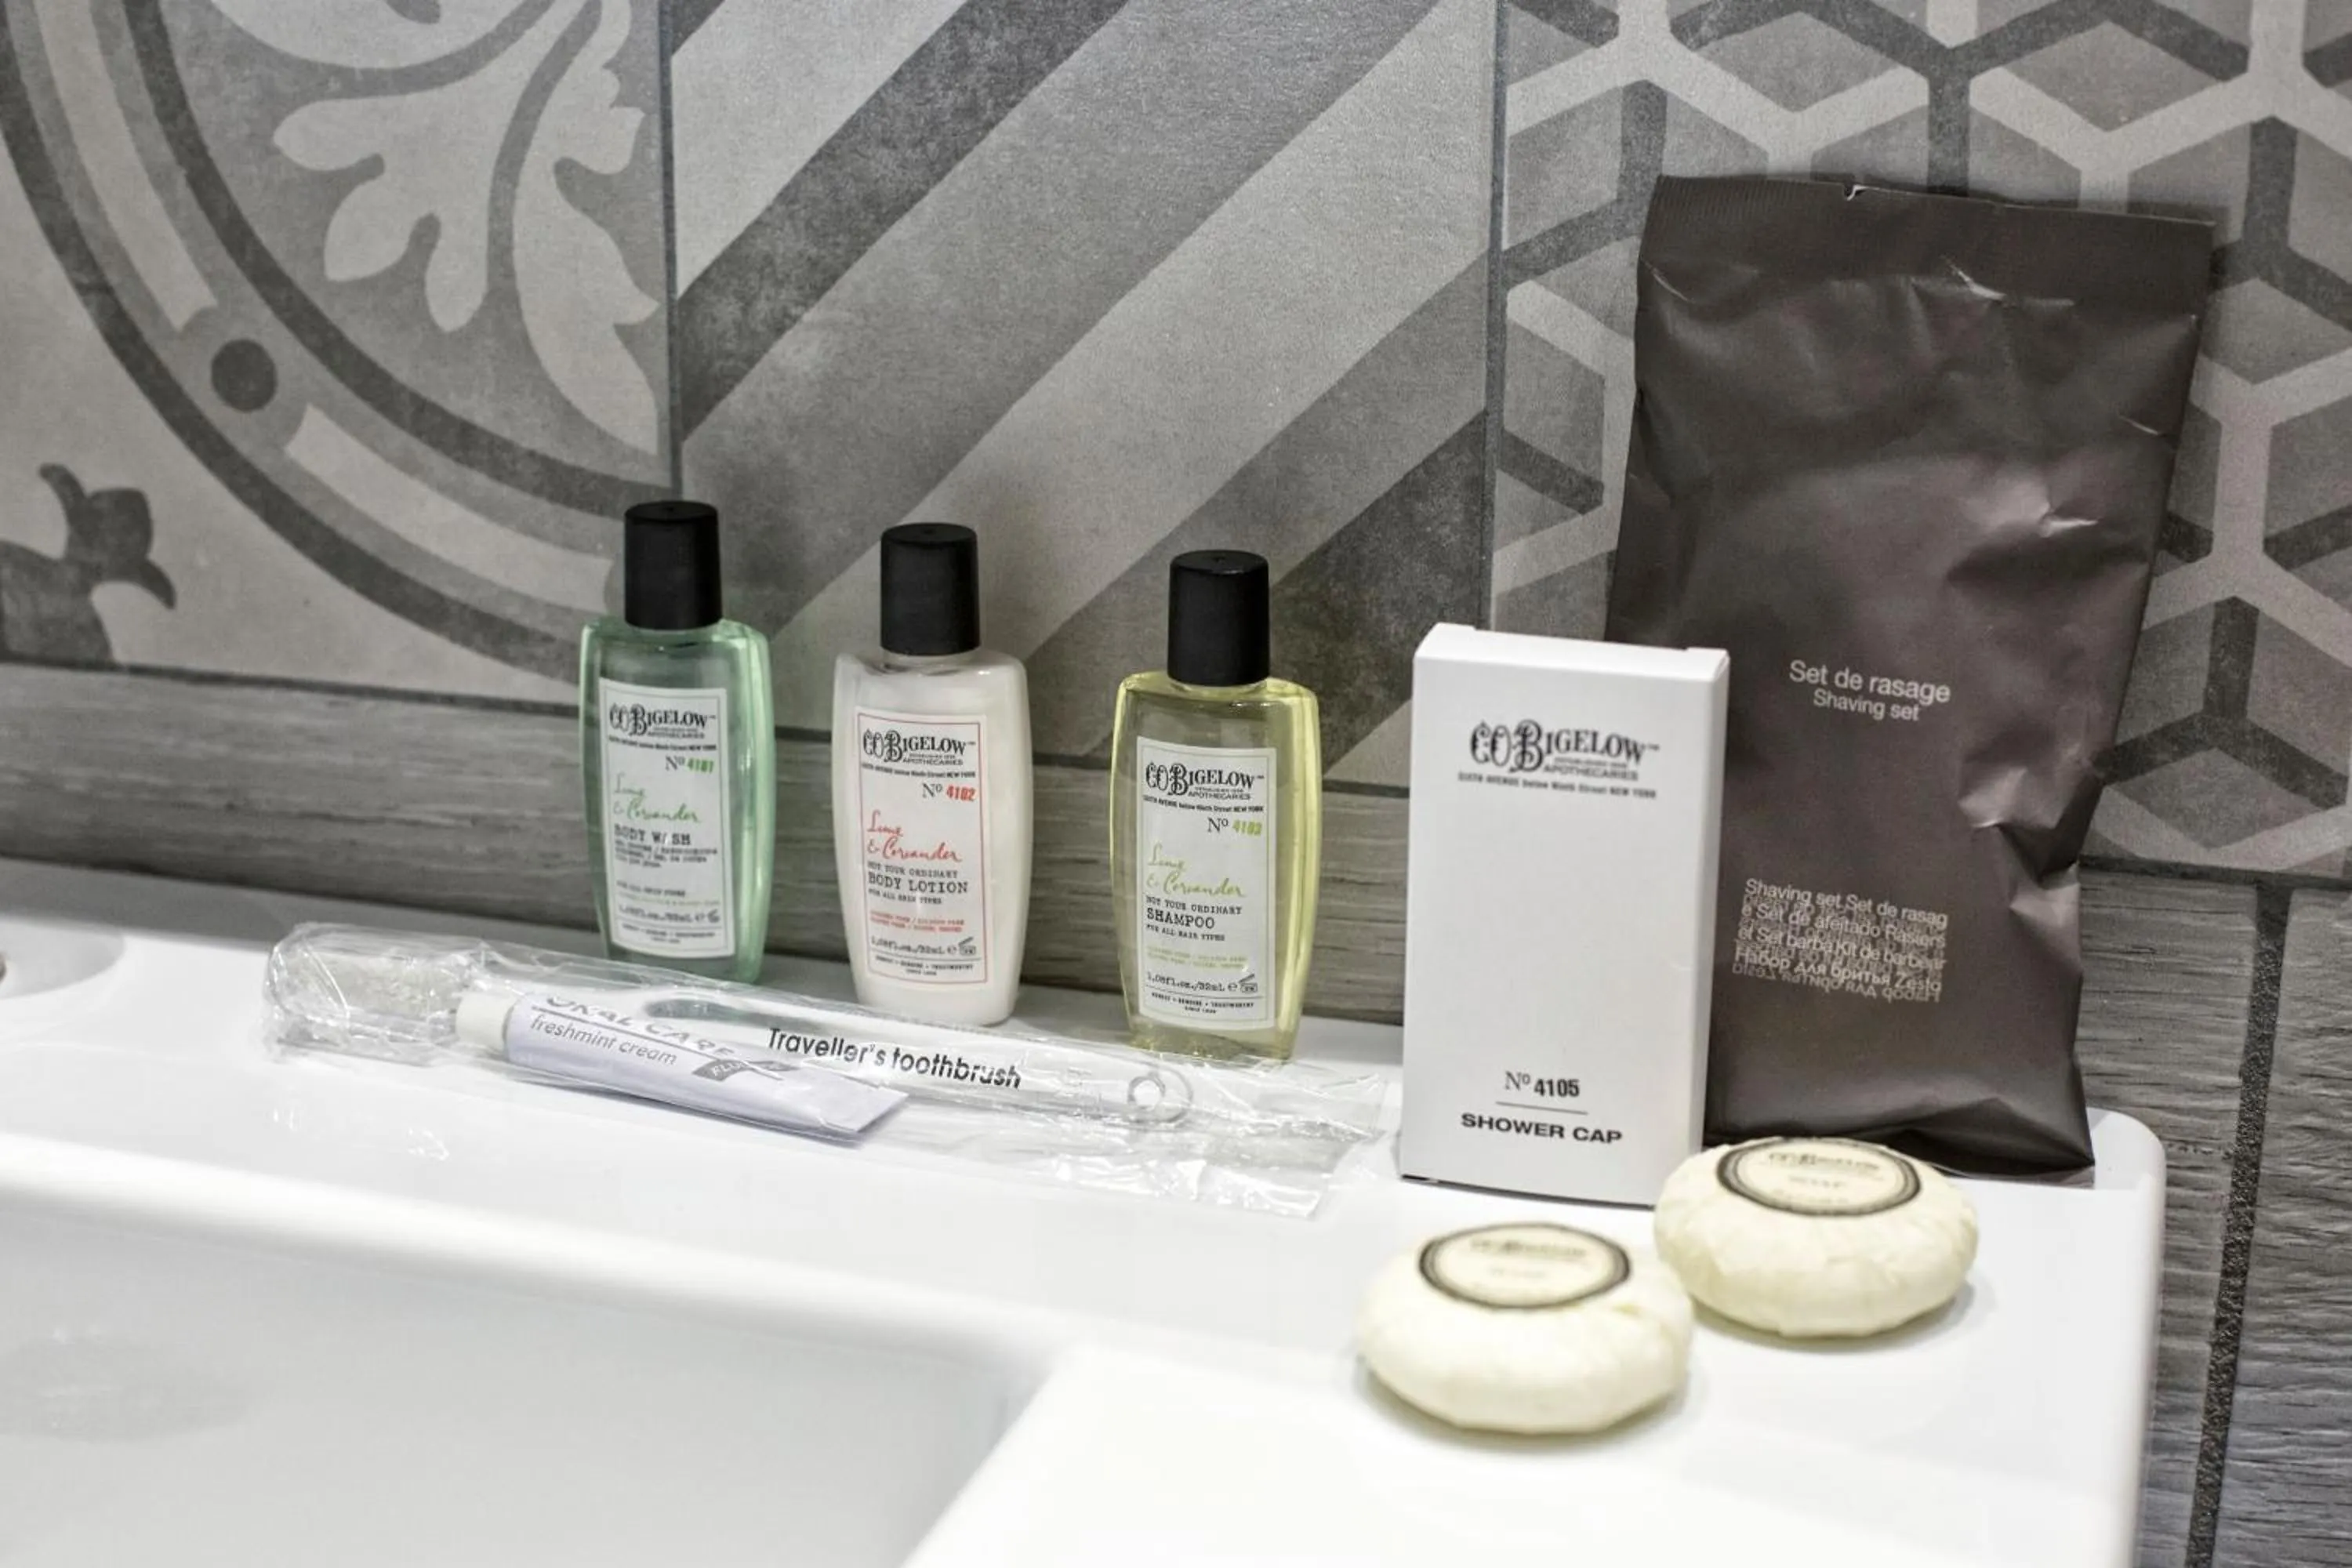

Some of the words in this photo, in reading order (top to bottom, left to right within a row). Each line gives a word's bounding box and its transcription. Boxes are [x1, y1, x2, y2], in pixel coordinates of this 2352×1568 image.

[1789, 659, 1828, 684] Set
[1834, 667, 1863, 691] de
[1869, 675, 1951, 706] rasage
[1813, 688, 1885, 720] Shaving
[1889, 703, 1920, 721] set
[882, 836, 963, 862] Coriander
[868, 872, 902, 890] BODY
[909, 880, 968, 894] LOTION
[1163, 871, 1247, 898] Coriander
[1191, 904, 1243, 915] ORDINARY
[1745, 878, 1812, 905] Shaving
[1816, 891, 1842, 909] set
[1846, 894, 1872, 913] Set
[1876, 900, 1898, 916] de
[1147, 907, 1215, 929] SHAMPOO
[1161, 927, 1175, 936] ALL
[530, 1014, 617, 1051] freshmint
[619, 1041, 677, 1065] cream
[766, 1027, 885, 1067] Traveller's
[893, 1047, 1021, 1090] toothbrush
[1534, 1078, 1581, 1098] 4105
[1461, 1113, 1566, 1139] SHOWER
[1572, 1127, 1623, 1144] CAP
